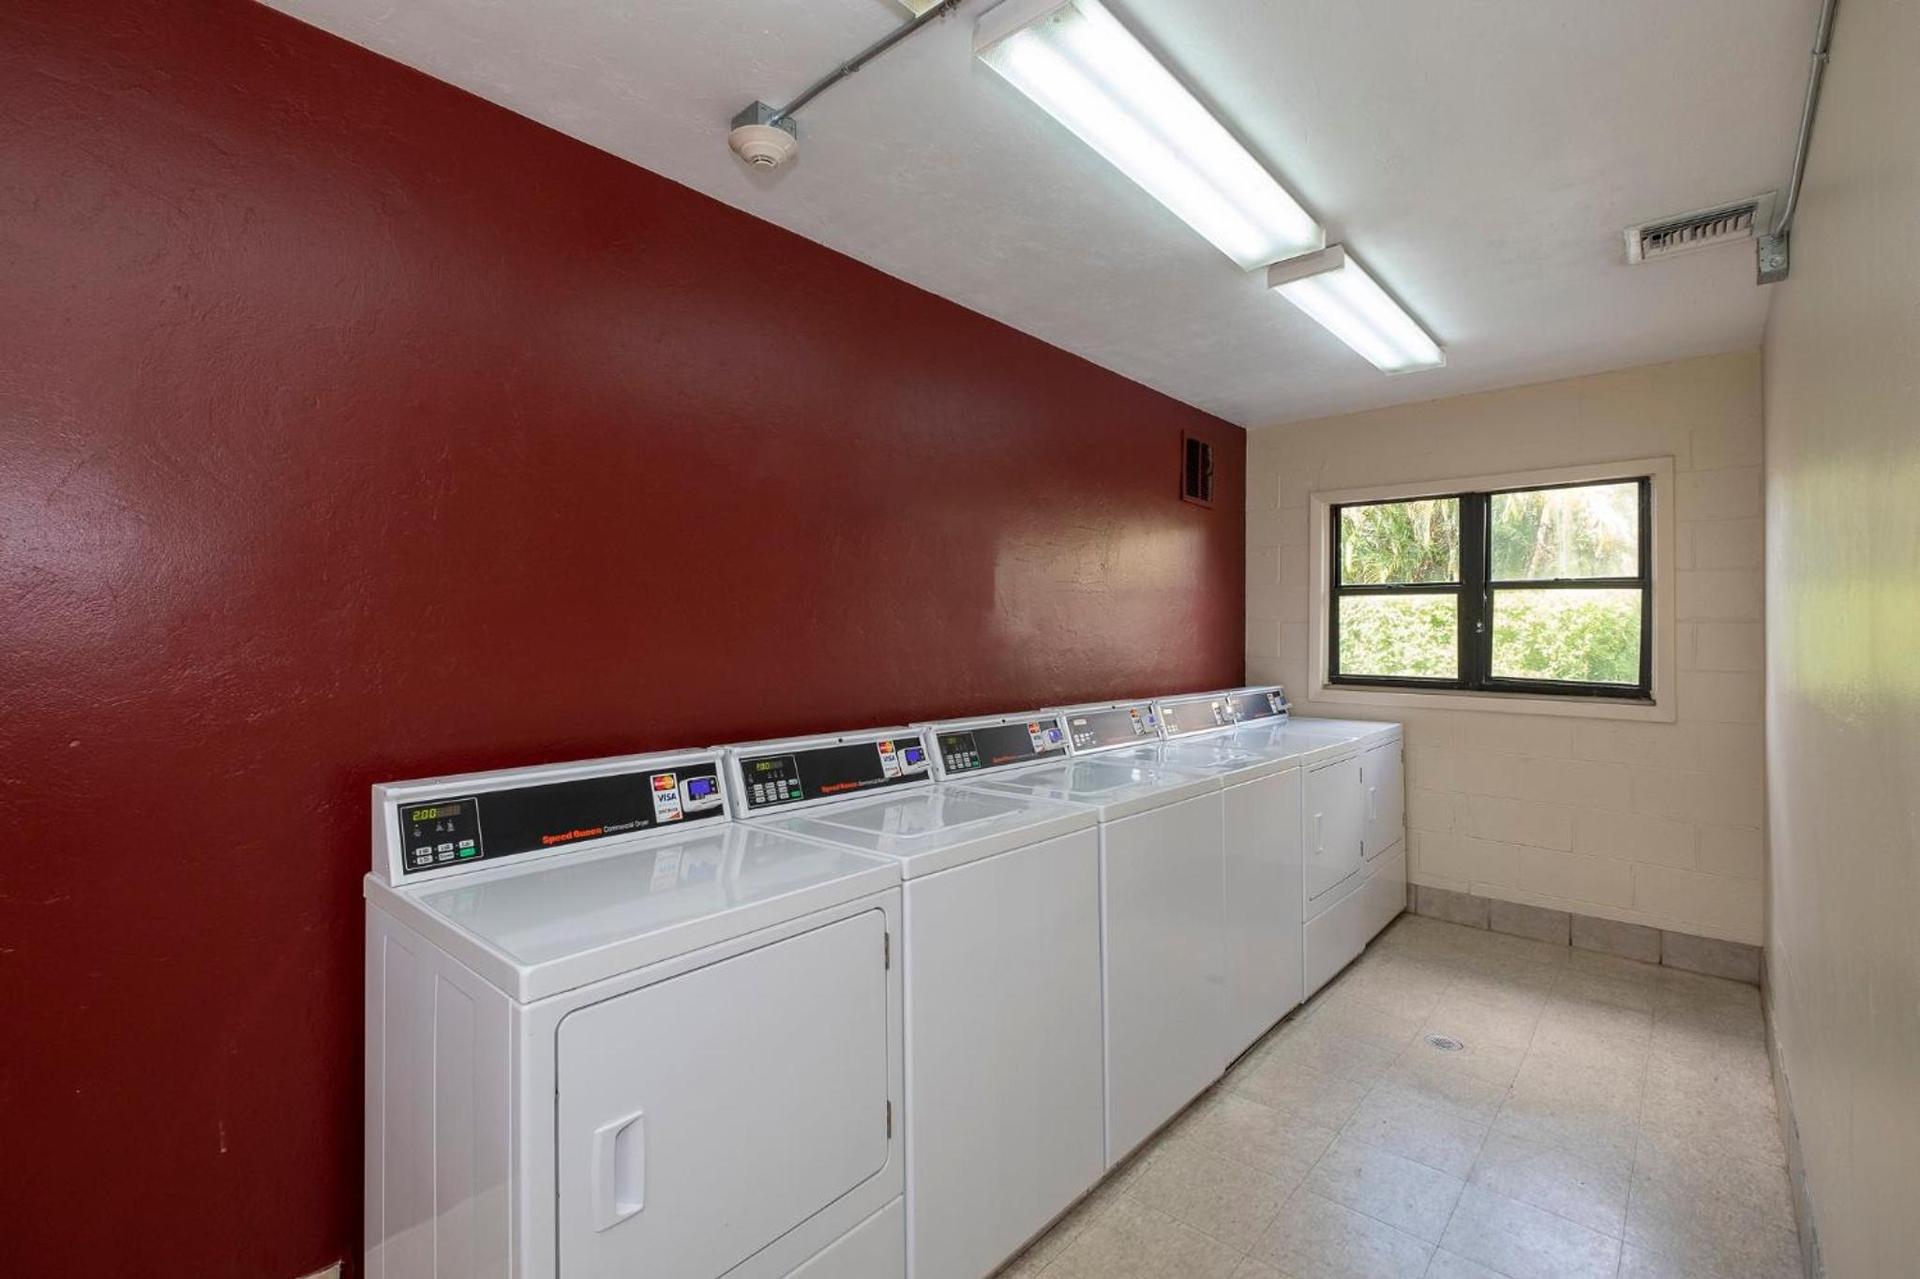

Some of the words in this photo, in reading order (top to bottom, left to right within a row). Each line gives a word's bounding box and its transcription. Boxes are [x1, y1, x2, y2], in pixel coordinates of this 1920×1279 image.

[657, 792, 677, 803] VISA
[542, 830, 573, 845] Speed
[573, 827, 603, 838] Queen
